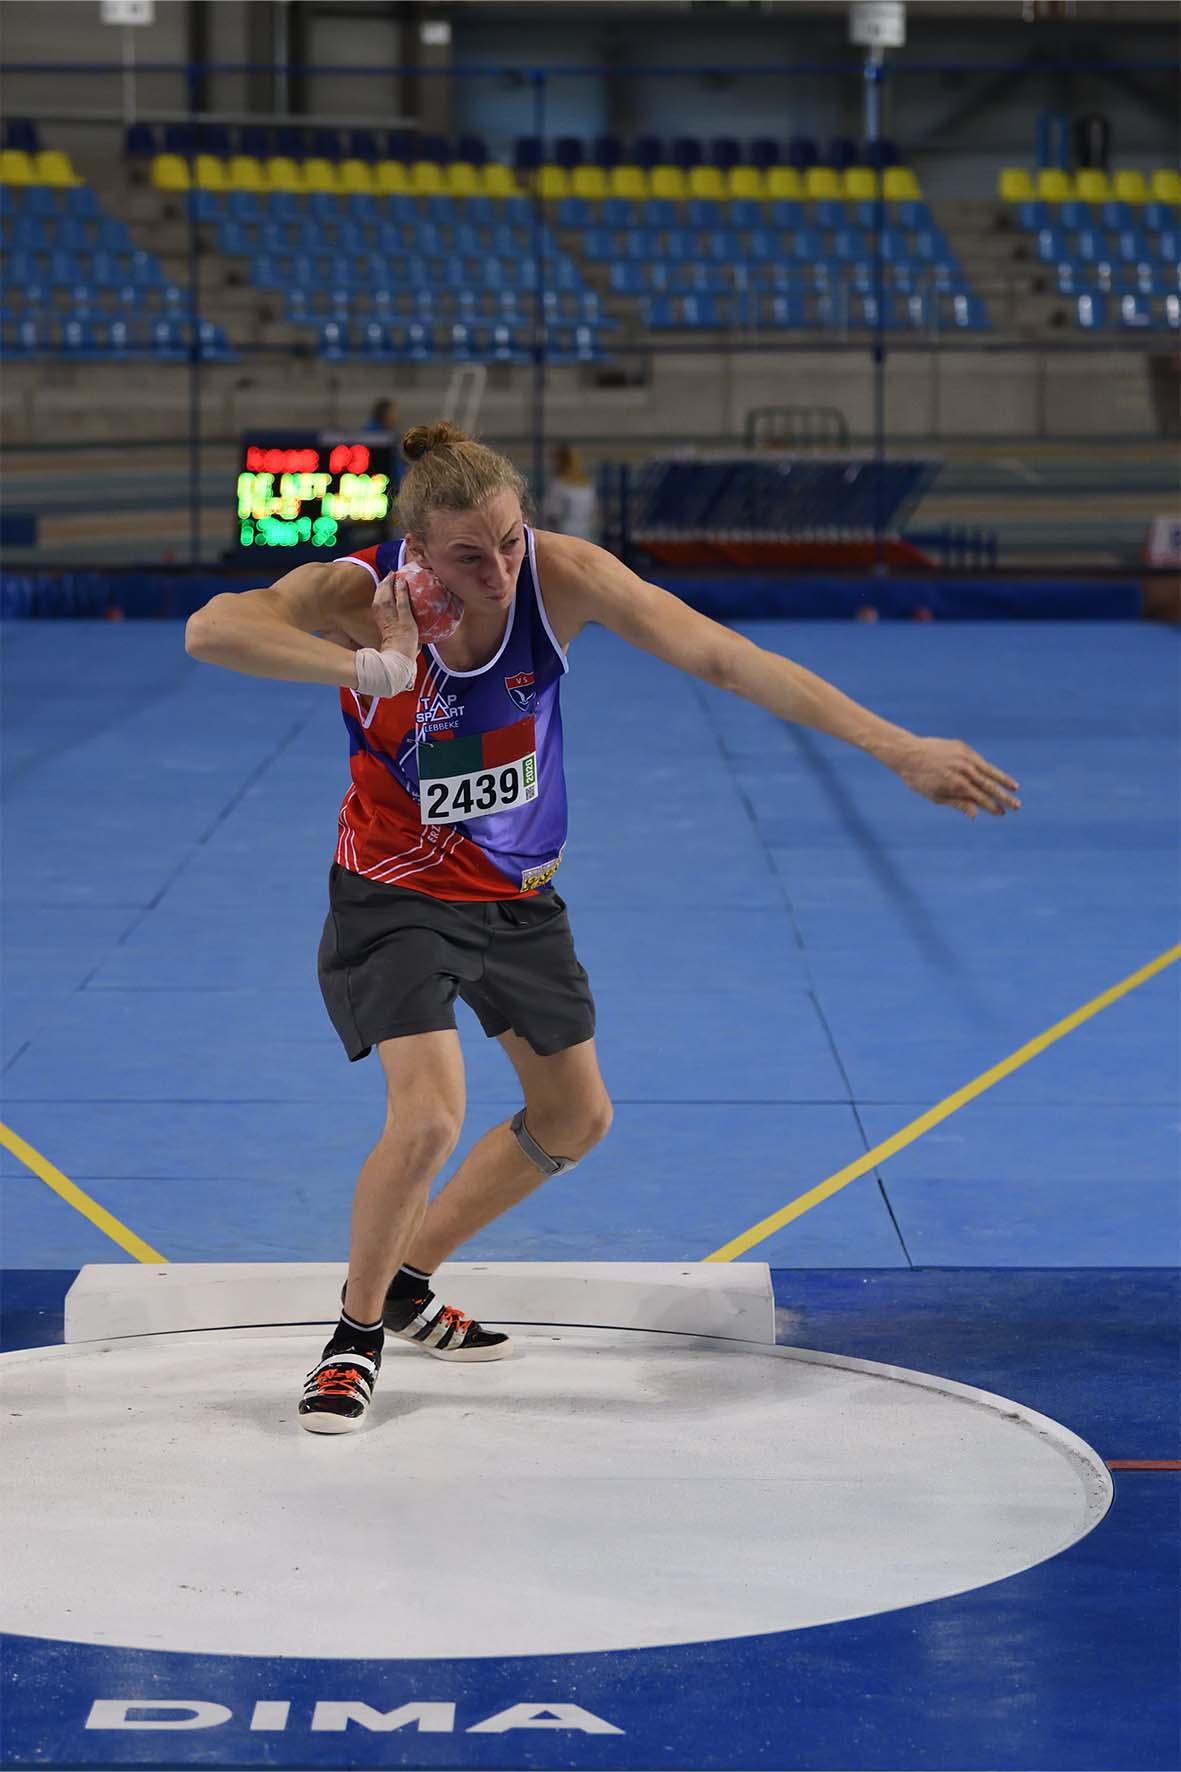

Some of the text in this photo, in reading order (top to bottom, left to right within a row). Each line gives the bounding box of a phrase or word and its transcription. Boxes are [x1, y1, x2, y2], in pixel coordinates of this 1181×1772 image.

[424, 721, 460, 732] LEBBEKE
[525, 758, 534, 784] 2020
[427, 767, 519, 819] 2439
[84, 1699, 626, 1735] DIMA
